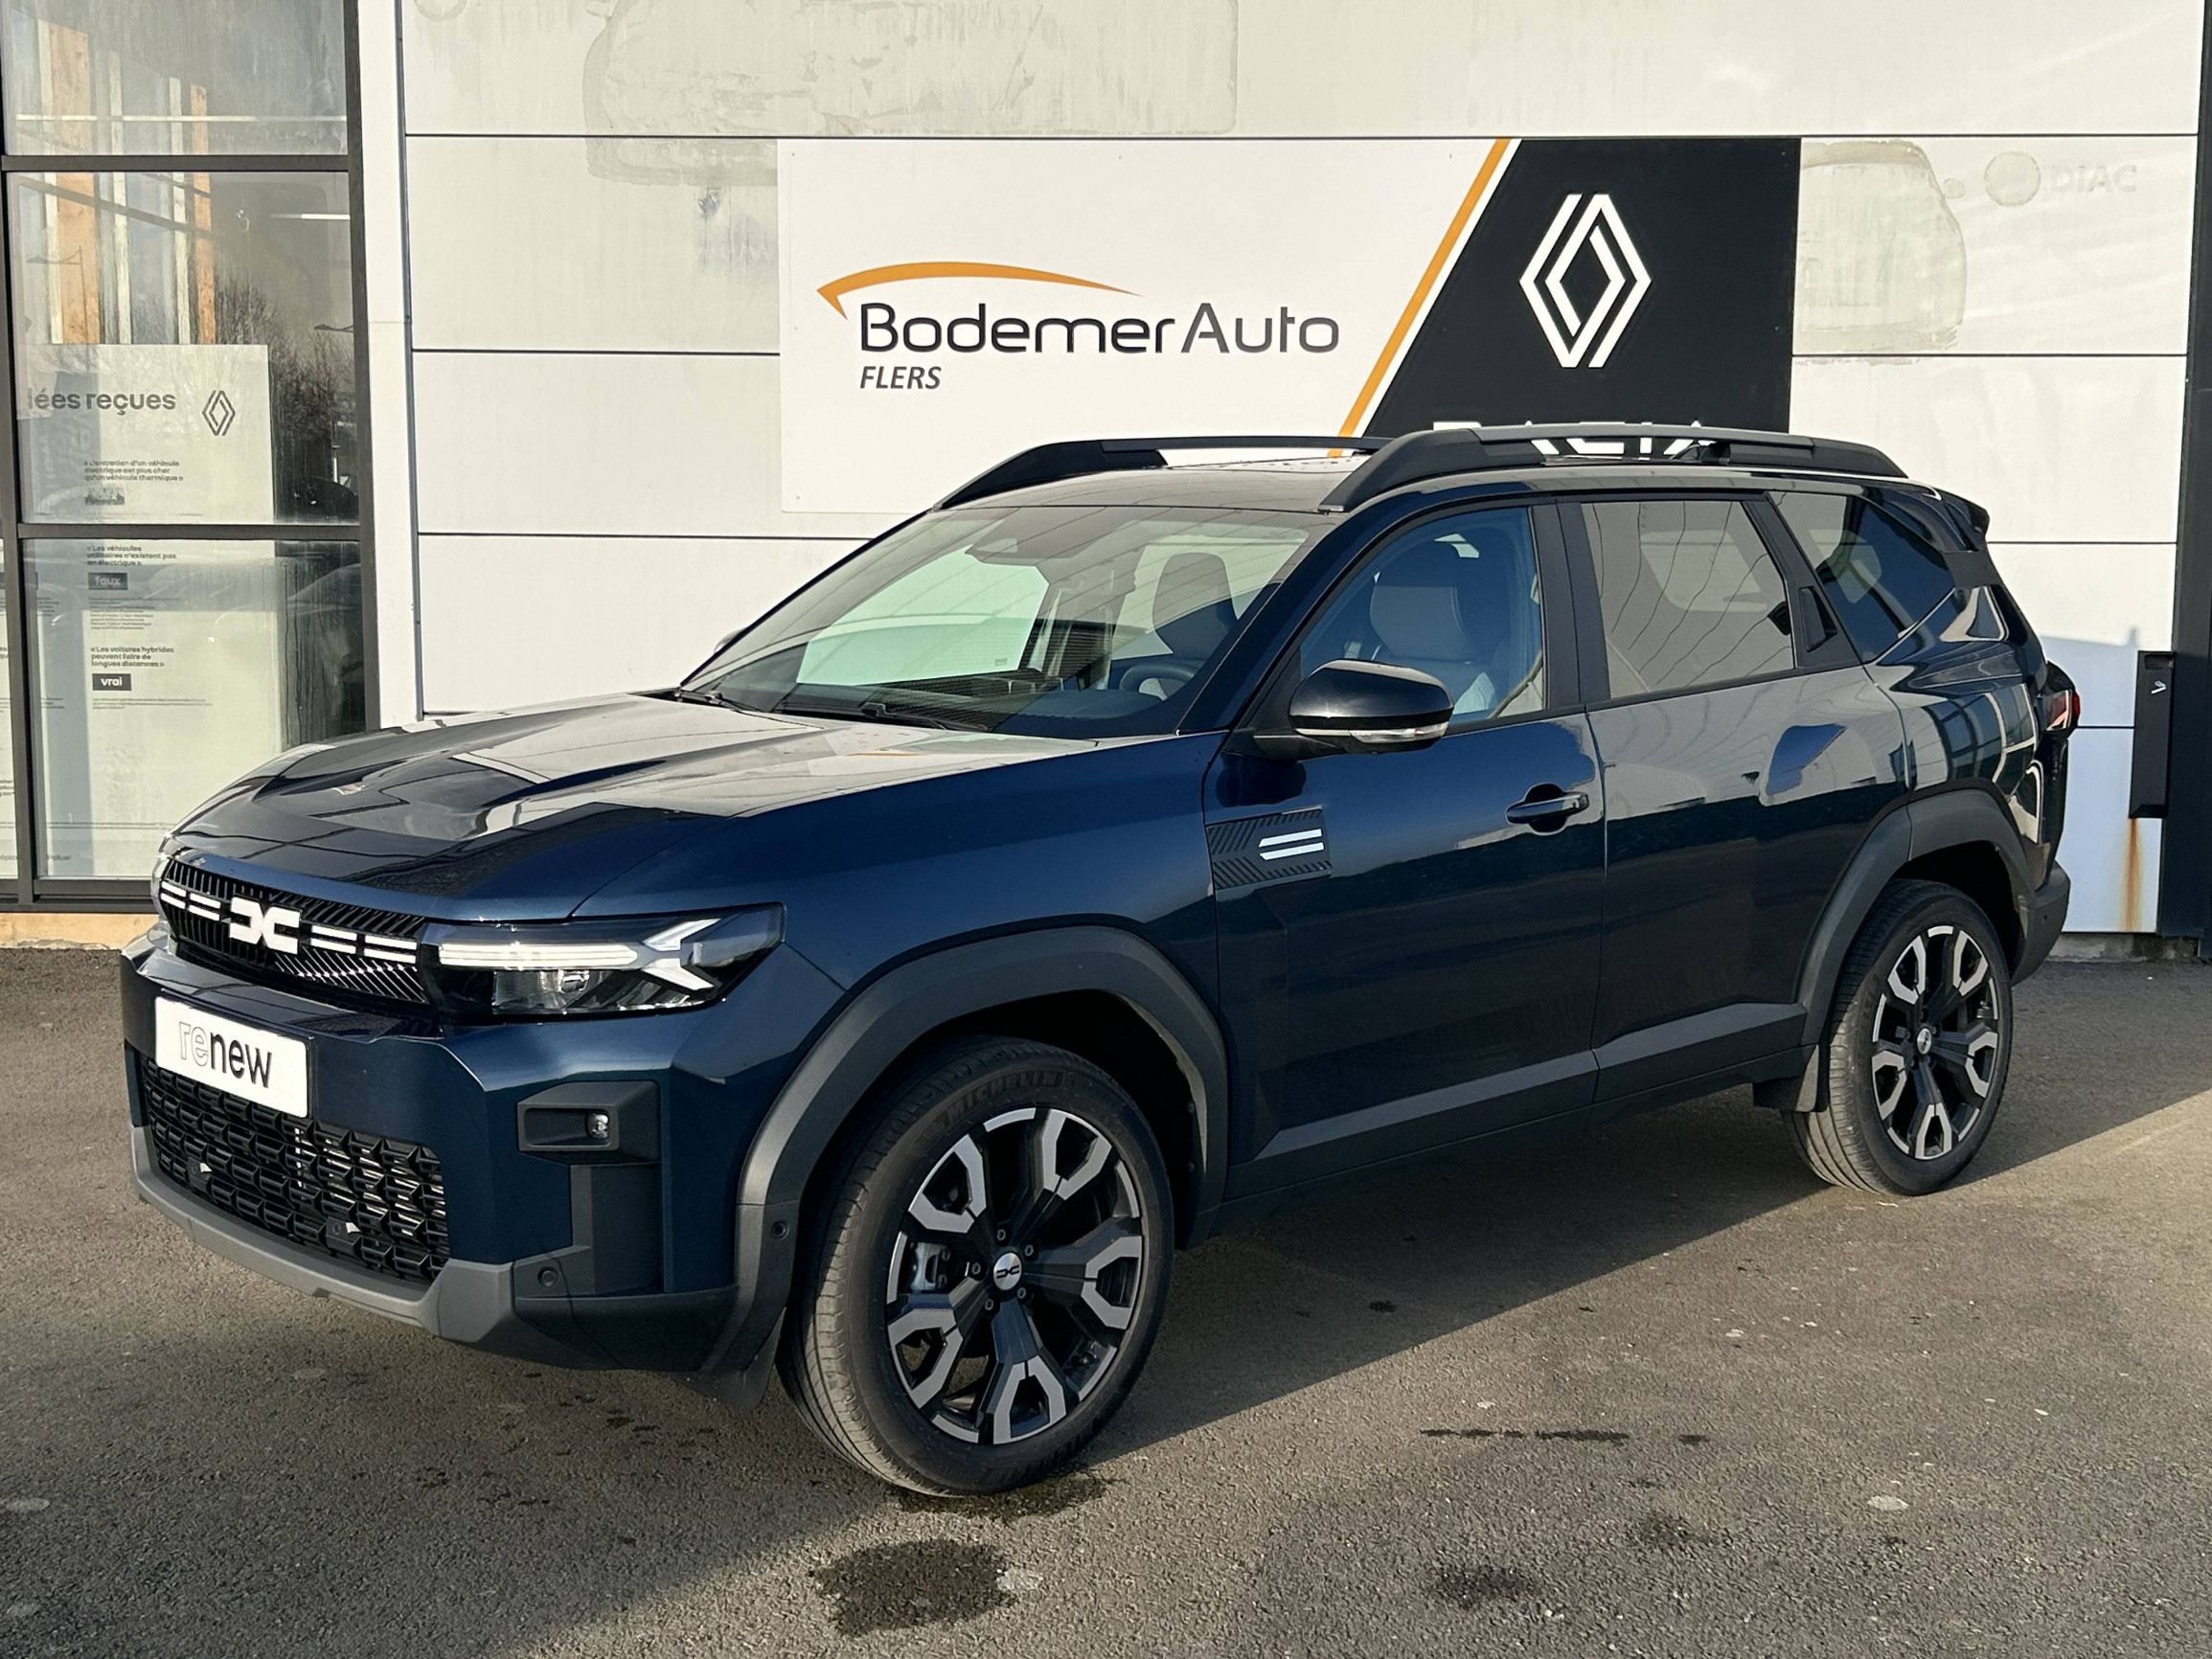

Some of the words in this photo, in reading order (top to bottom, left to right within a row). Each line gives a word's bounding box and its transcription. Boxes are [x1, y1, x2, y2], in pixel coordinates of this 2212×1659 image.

[859, 366, 942, 390] FLERS
[86, 393, 176, 416] reçues
[95, 576, 122, 586] faux
[101, 675, 123, 687] vrai
[178, 1020, 272, 1089] renew
